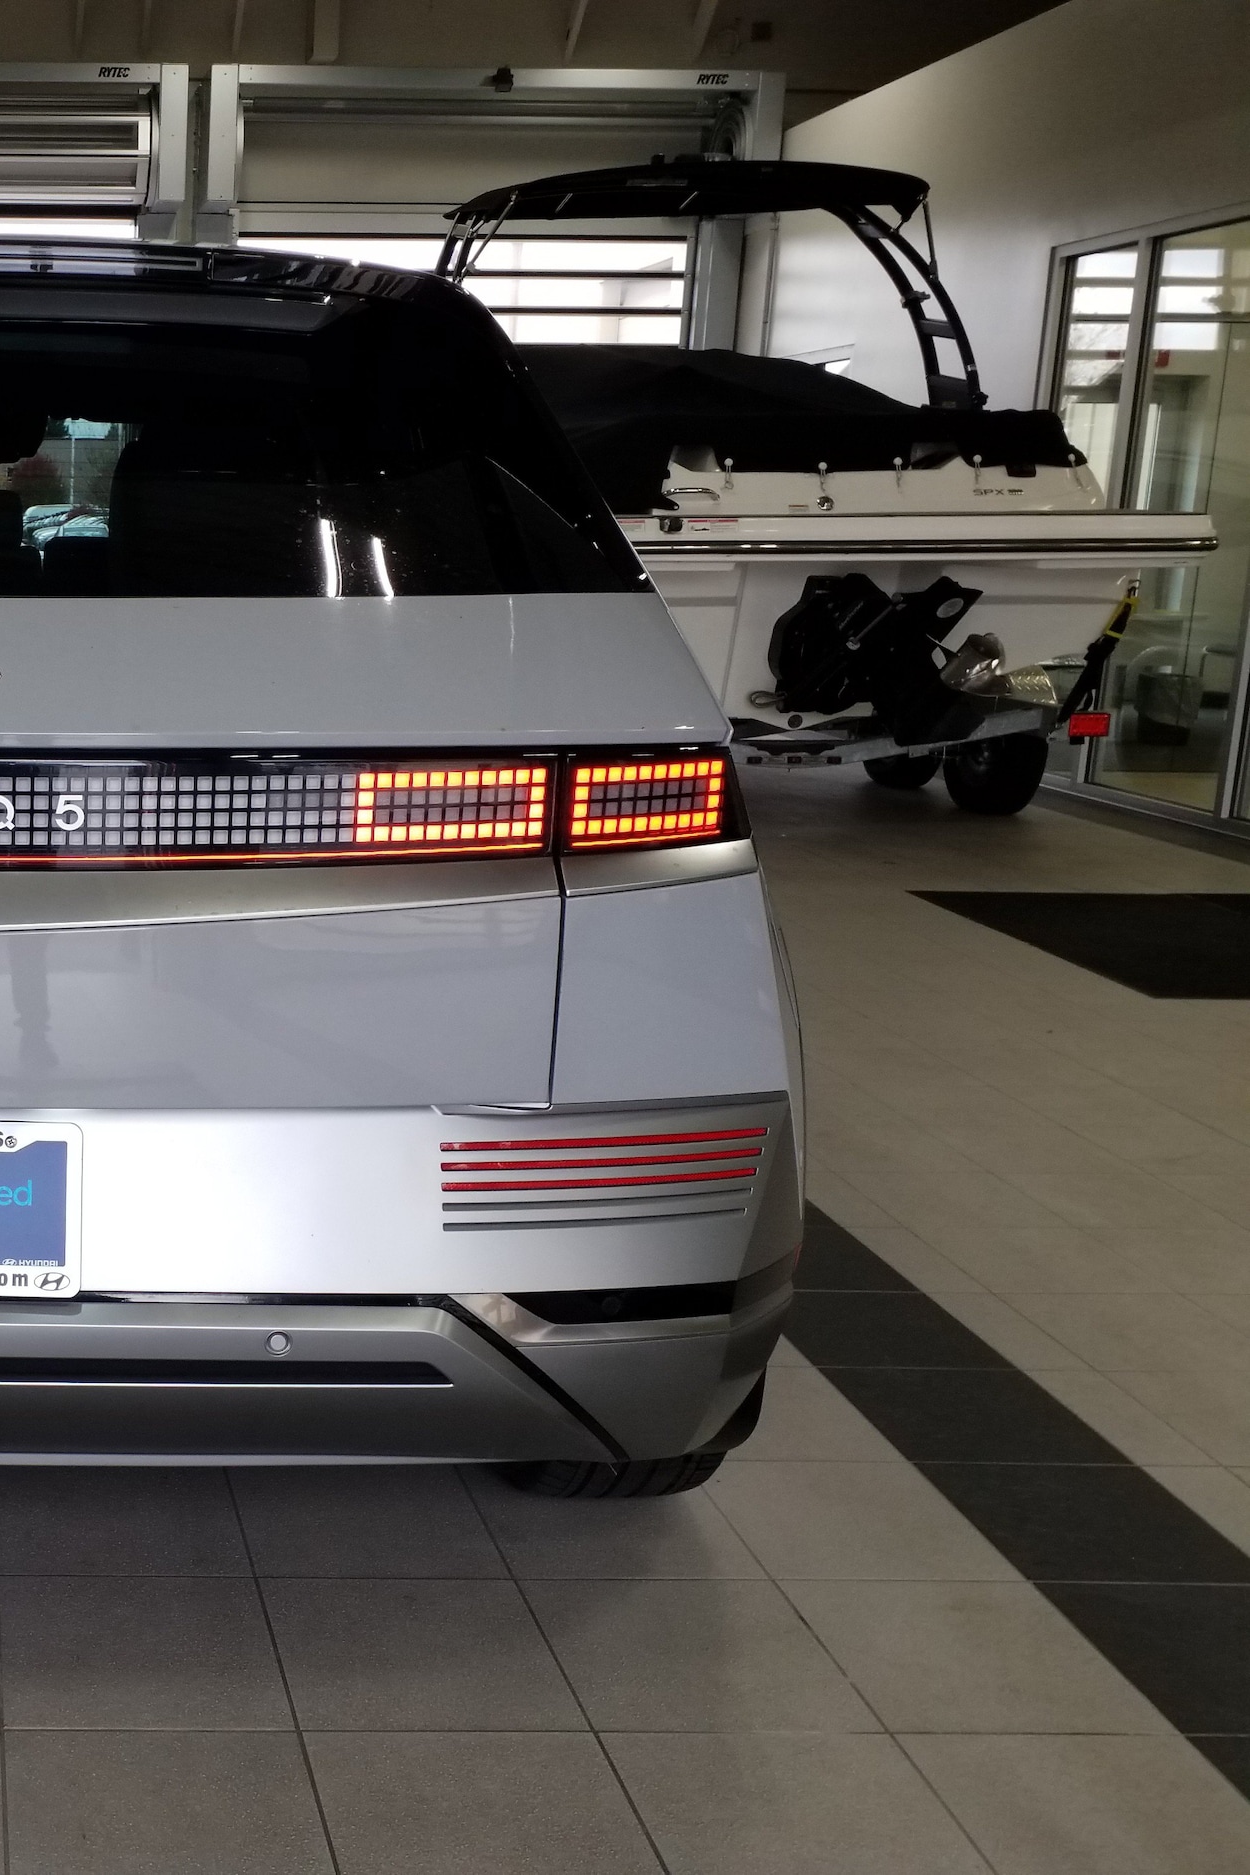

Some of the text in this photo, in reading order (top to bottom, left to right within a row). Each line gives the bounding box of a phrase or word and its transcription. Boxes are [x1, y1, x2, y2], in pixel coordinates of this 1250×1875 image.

[98, 66, 130, 78] RYTEC
[696, 73, 729, 85] RYTEC
[54, 795, 85, 831] 5
